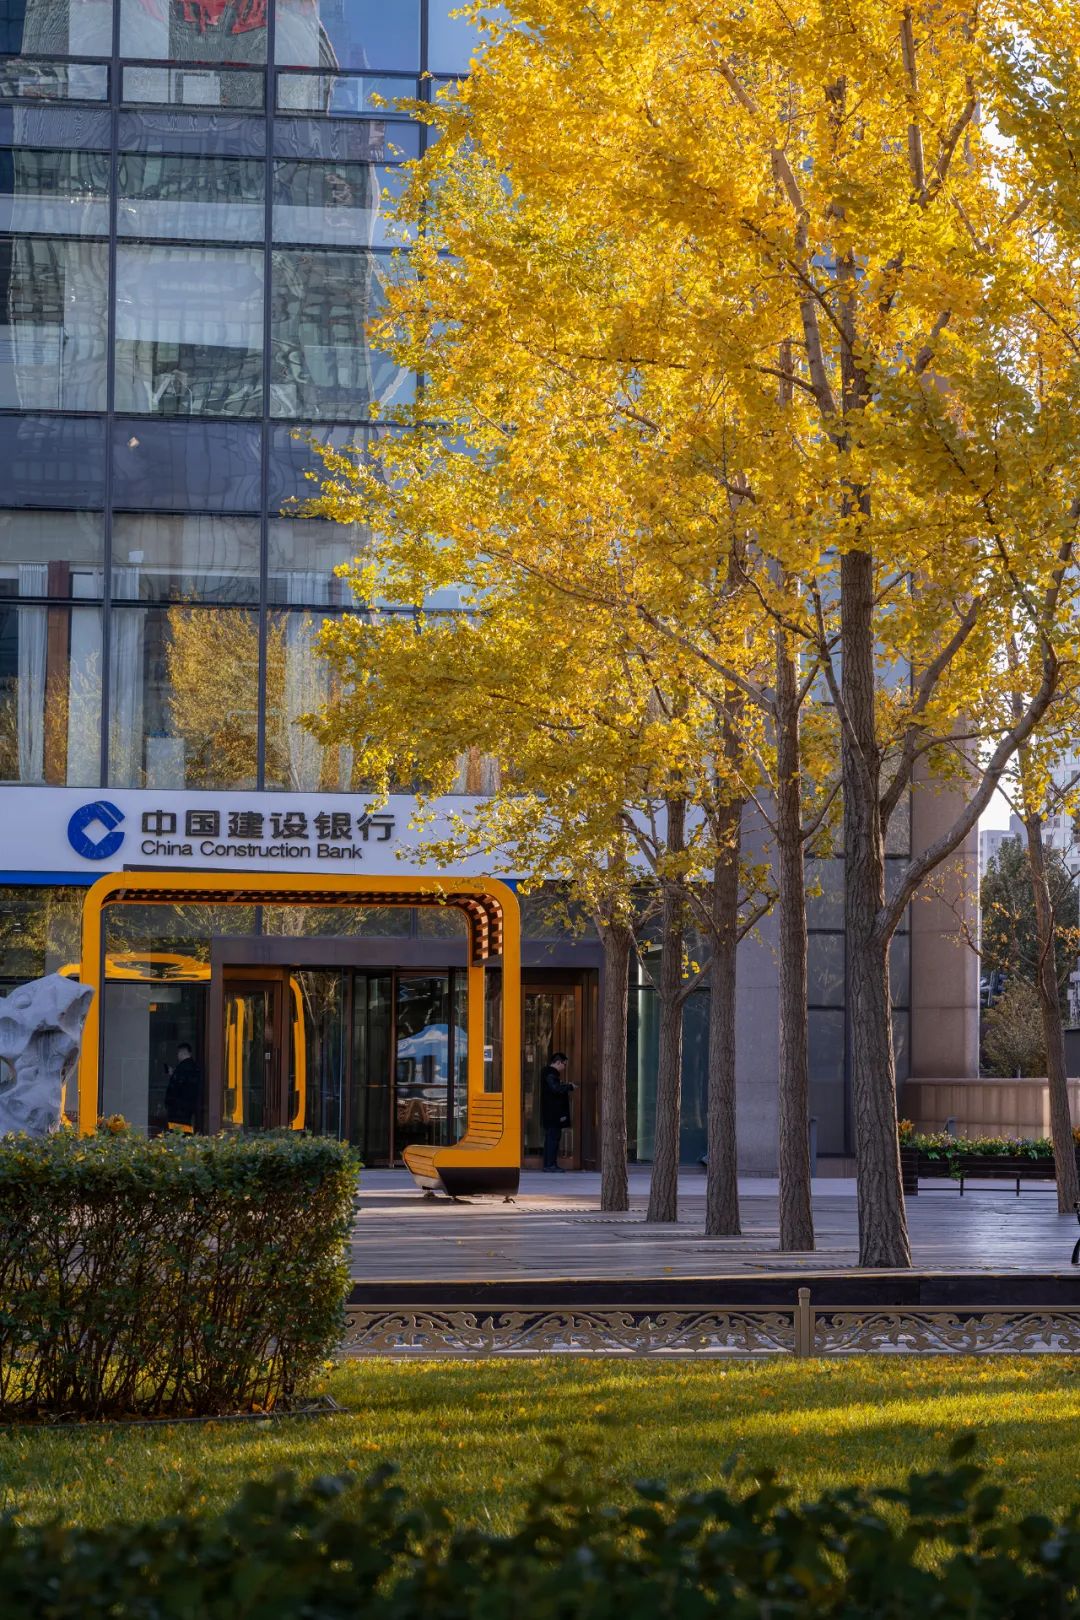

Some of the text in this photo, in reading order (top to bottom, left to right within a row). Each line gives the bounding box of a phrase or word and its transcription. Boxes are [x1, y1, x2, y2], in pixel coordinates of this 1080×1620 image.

[141, 809, 395, 841] 中国建设银行
[141, 840, 363, 859] China Construction Bank
